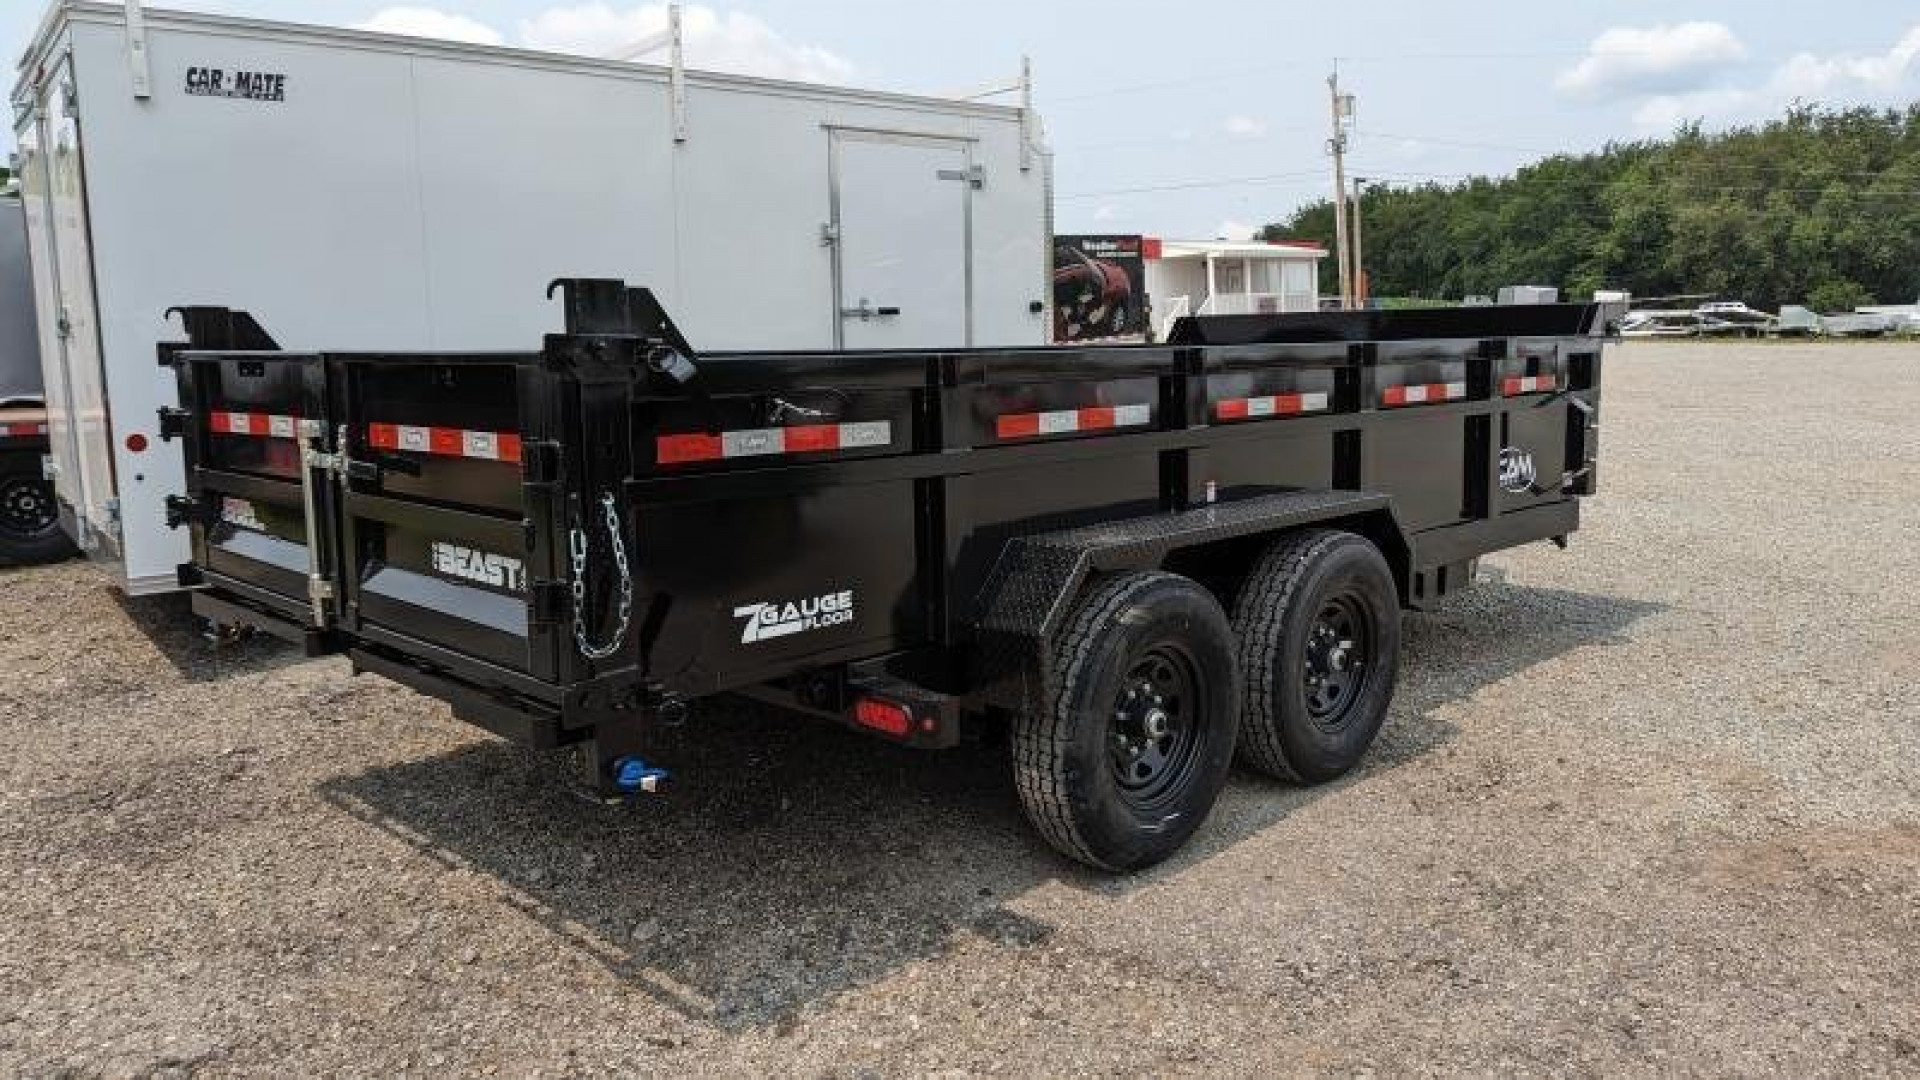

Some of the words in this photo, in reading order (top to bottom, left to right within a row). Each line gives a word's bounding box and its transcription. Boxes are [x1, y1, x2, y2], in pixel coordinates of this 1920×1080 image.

[186, 67, 222, 89] CAR
[235, 72, 283, 92] MATE
[439, 542, 521, 589] BEAST
[760, 590, 852, 624] GAUGE
[802, 609, 852, 630] FLOOR
